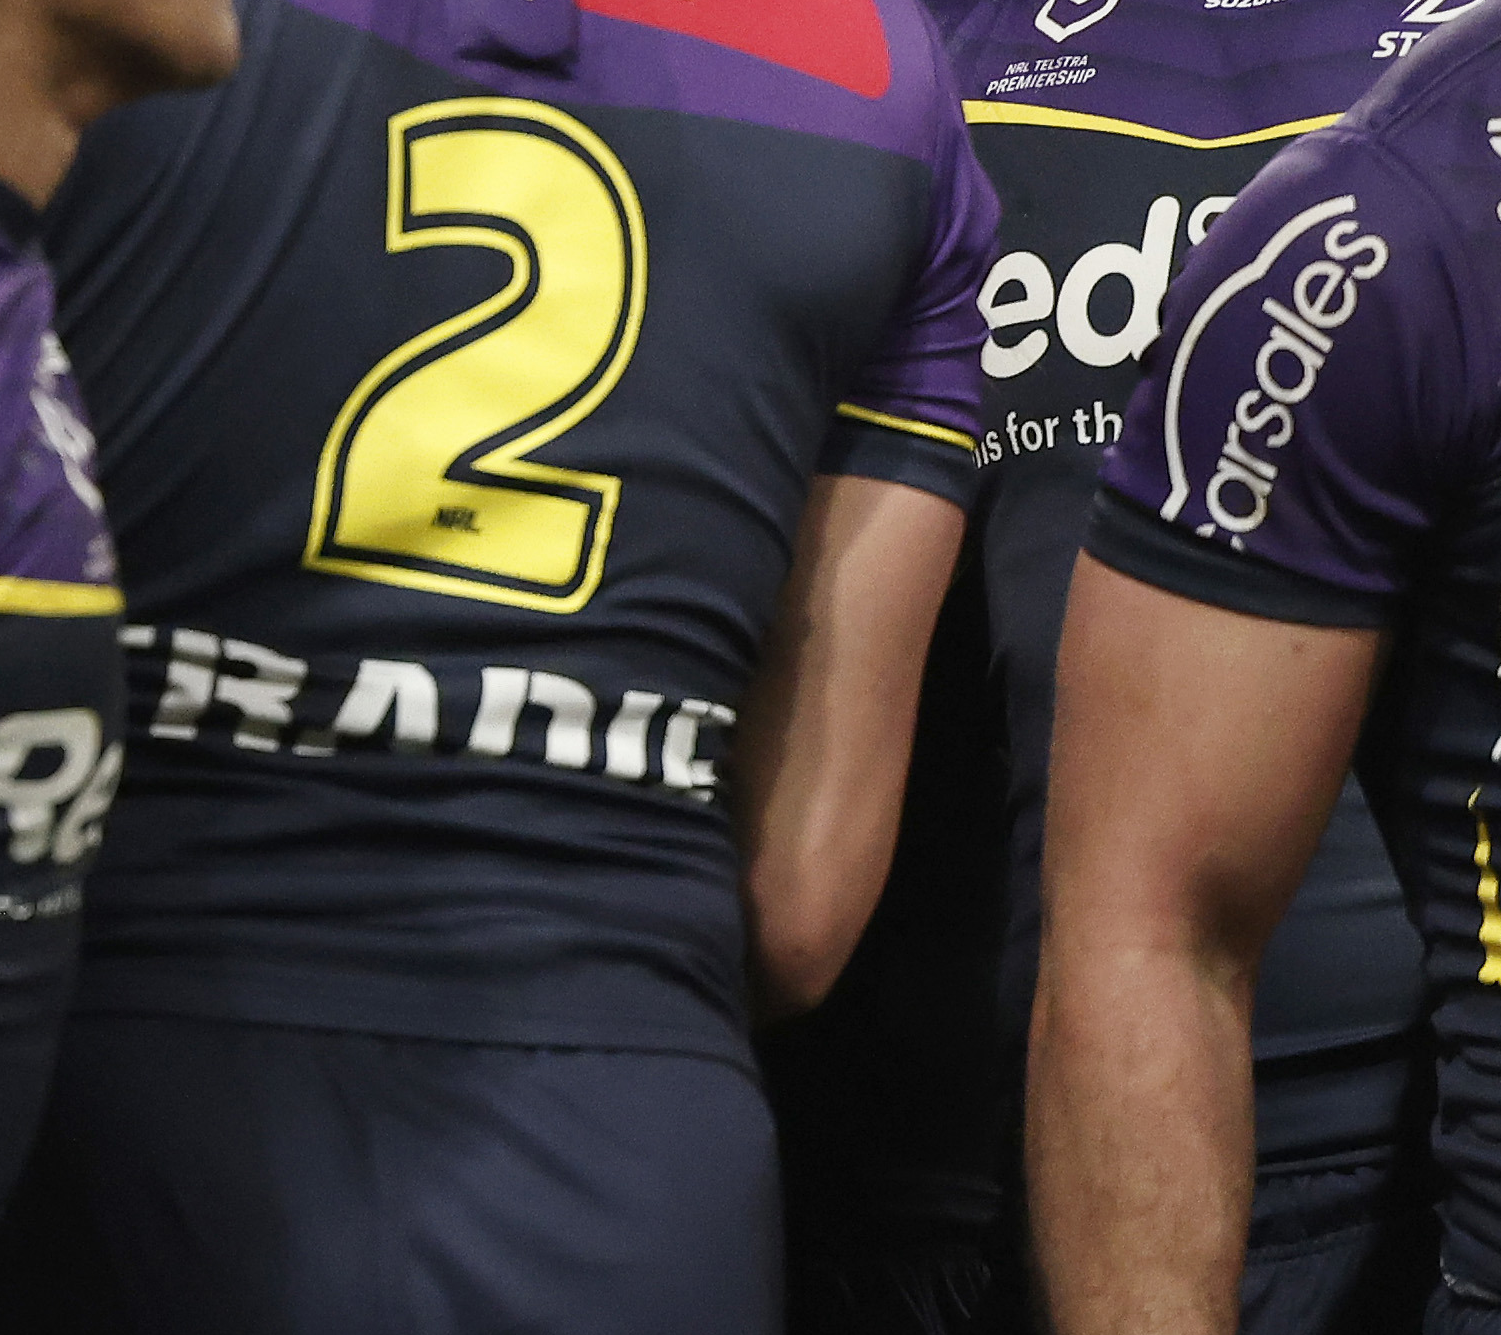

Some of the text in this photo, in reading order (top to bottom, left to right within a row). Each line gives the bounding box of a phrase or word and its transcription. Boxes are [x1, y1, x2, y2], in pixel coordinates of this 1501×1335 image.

[985, 67, 1097, 96] PREMIERSHIP
[1005, 54, 1089, 76] NRL TELSTRA
[304, 97, 648, 614] 2
[1006, 410, 1061, 457] for
